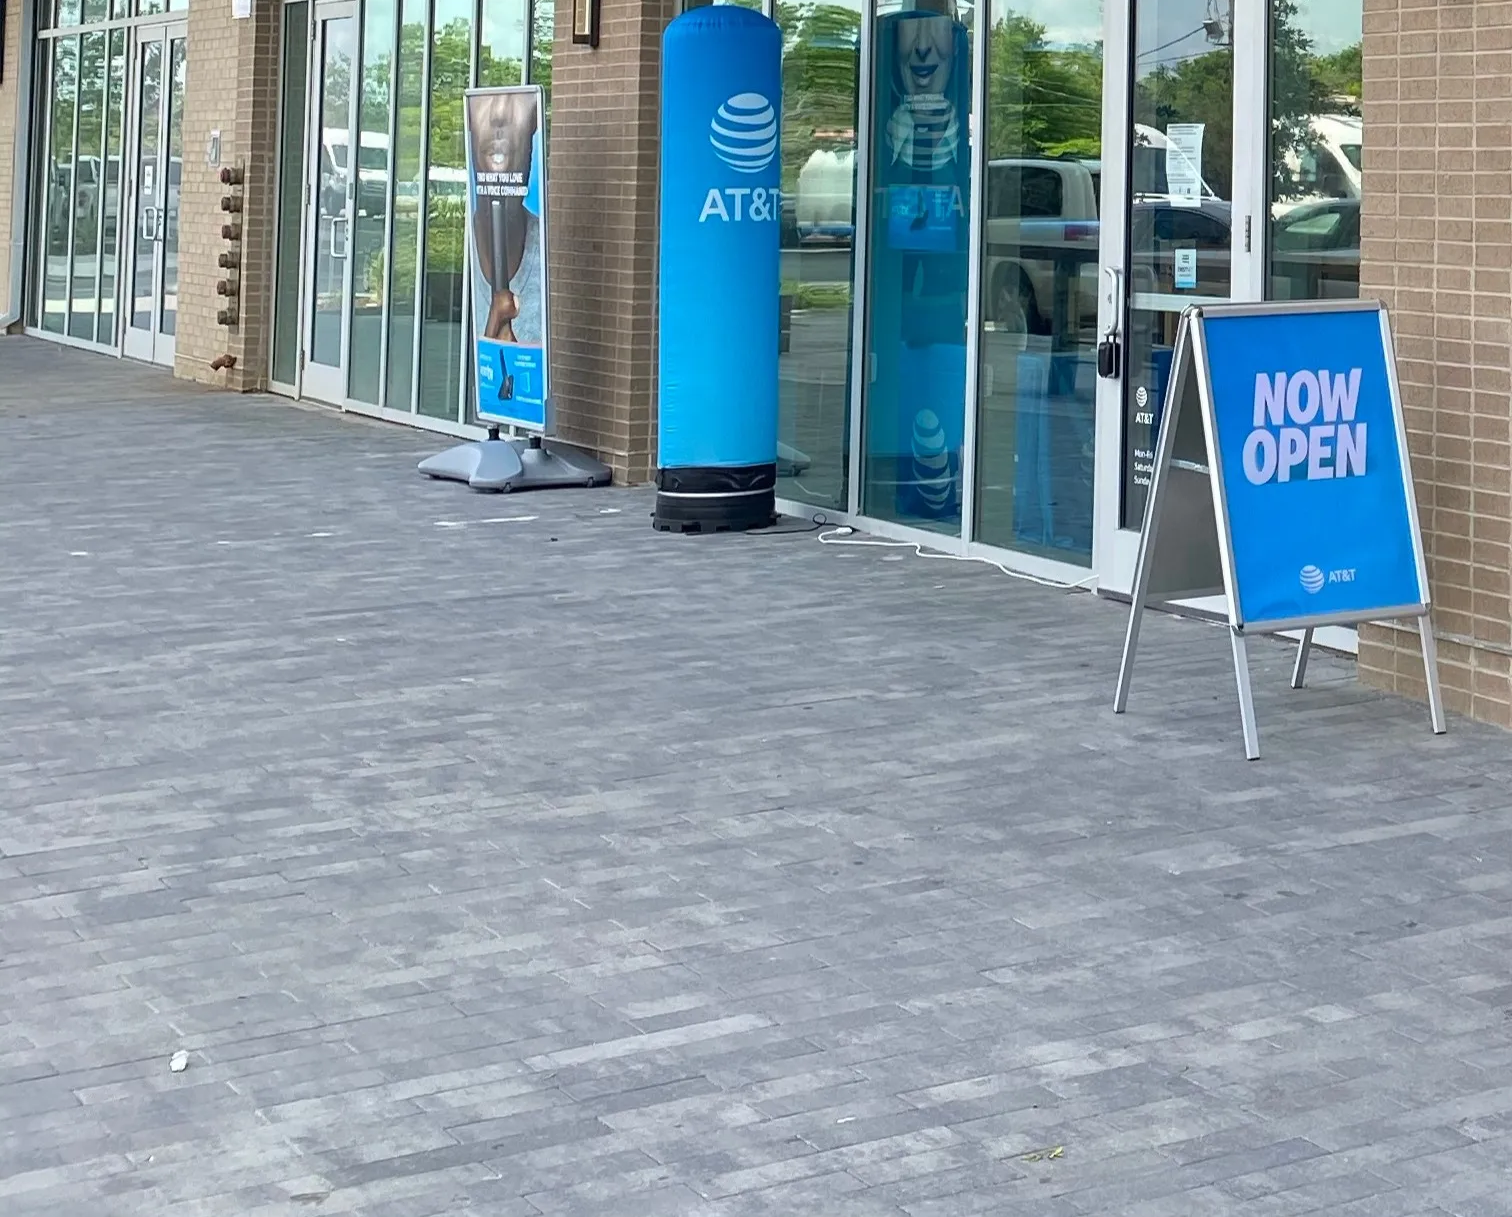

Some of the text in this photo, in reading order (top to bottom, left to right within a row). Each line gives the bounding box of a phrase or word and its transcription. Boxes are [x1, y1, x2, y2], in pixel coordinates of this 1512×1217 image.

[699, 187, 779, 222] AT&T
[1252, 368, 1362, 427] NOW
[1135, 412, 1154, 425] AT&T
[1134, 448, 1153, 459] Mon-Fri
[1242, 422, 1367, 486] OPEN
[1134, 462, 1153, 472] Saturda
[1134, 475, 1150, 485] Sunda
[1328, 568, 1356, 583] AT&T
